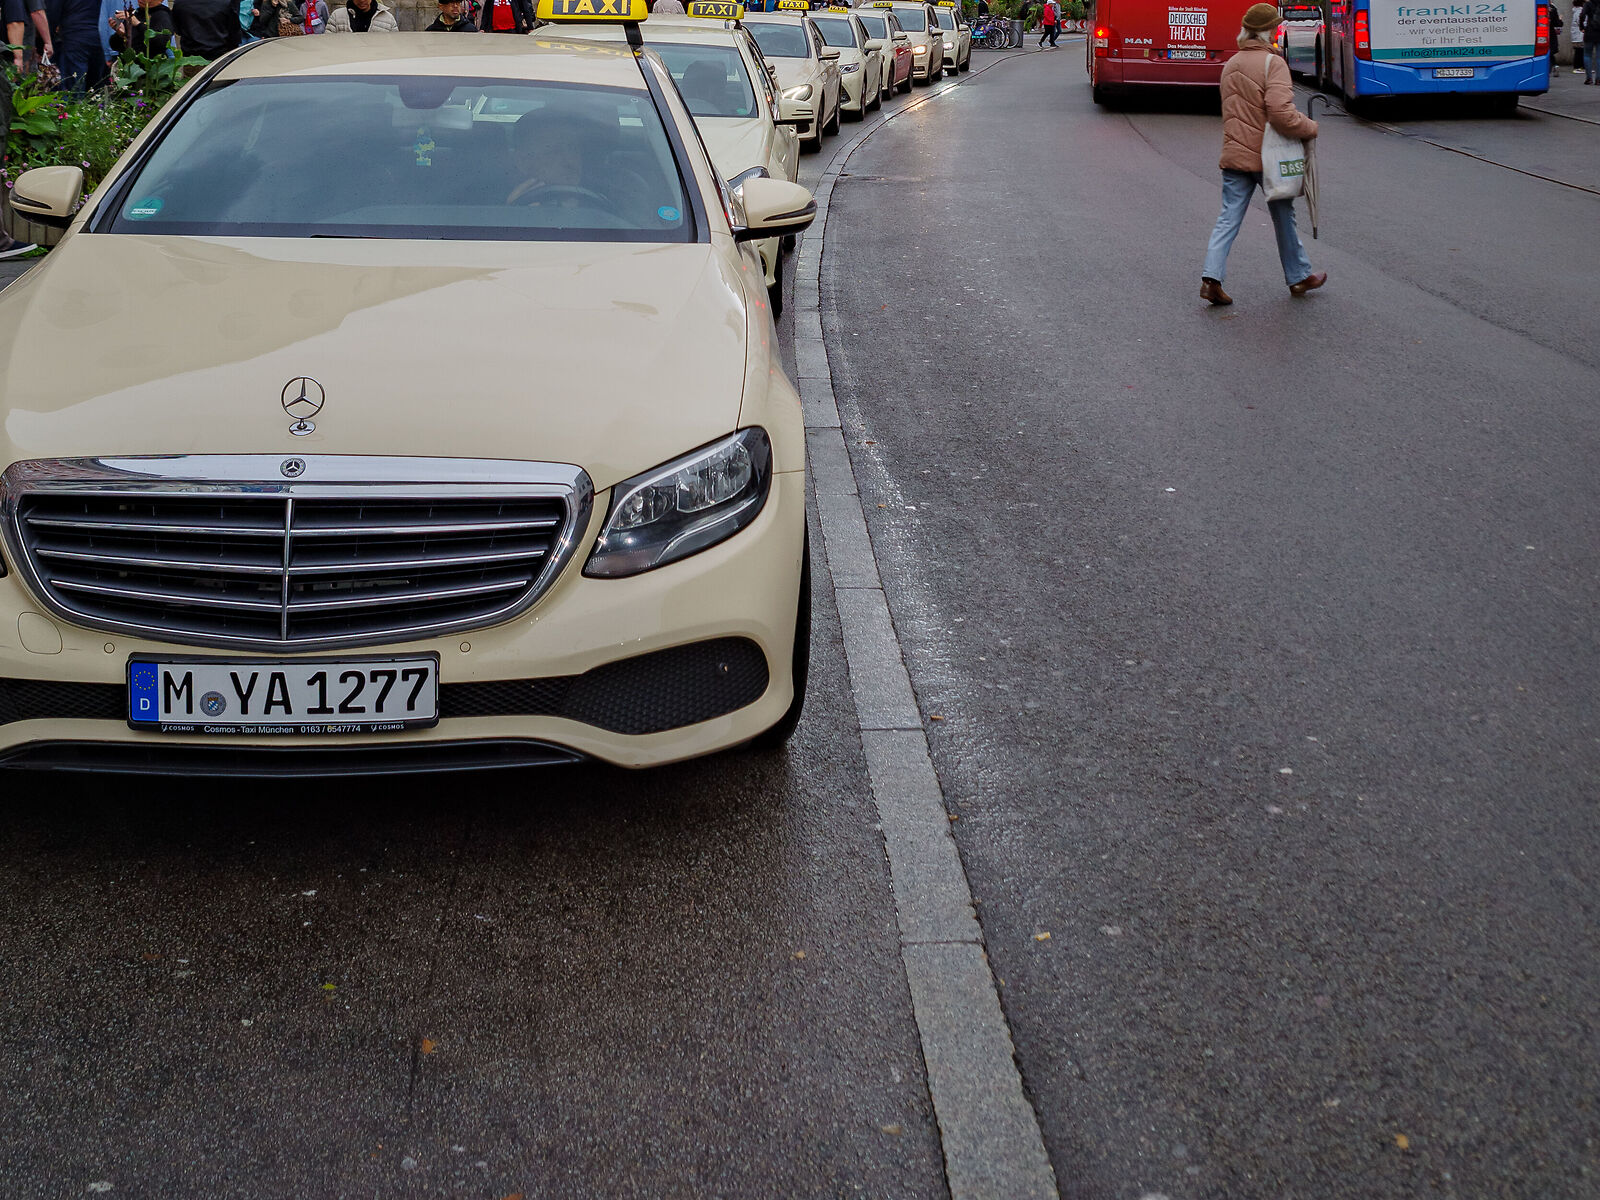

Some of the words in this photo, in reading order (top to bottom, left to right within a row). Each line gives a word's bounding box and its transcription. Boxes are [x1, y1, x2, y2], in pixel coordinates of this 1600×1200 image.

[697, 3, 733, 16] TAXI
[783, 1, 804, 9] TAXI
[1170, 14, 1206, 24] DEUTSCHES
[1419, 15, 1507, 25] eventausstatter
[1170, 26, 1205, 40] THEATER
[1409, 27, 1426, 35] wir
[1428, 27, 1480, 35] verleihen
[1482, 25, 1508, 33] alles
[1422, 36, 1437, 45] für
[1440, 36, 1454, 44] Ihr
[1458, 35, 1482, 44] Fest
[163, 671, 193, 714] M
[229, 670, 293, 715] YA
[306, 667, 430, 715] 1277
[140, 698, 150, 710] D
[258, 725, 294, 734] München
[300, 725, 321, 734] 0163
